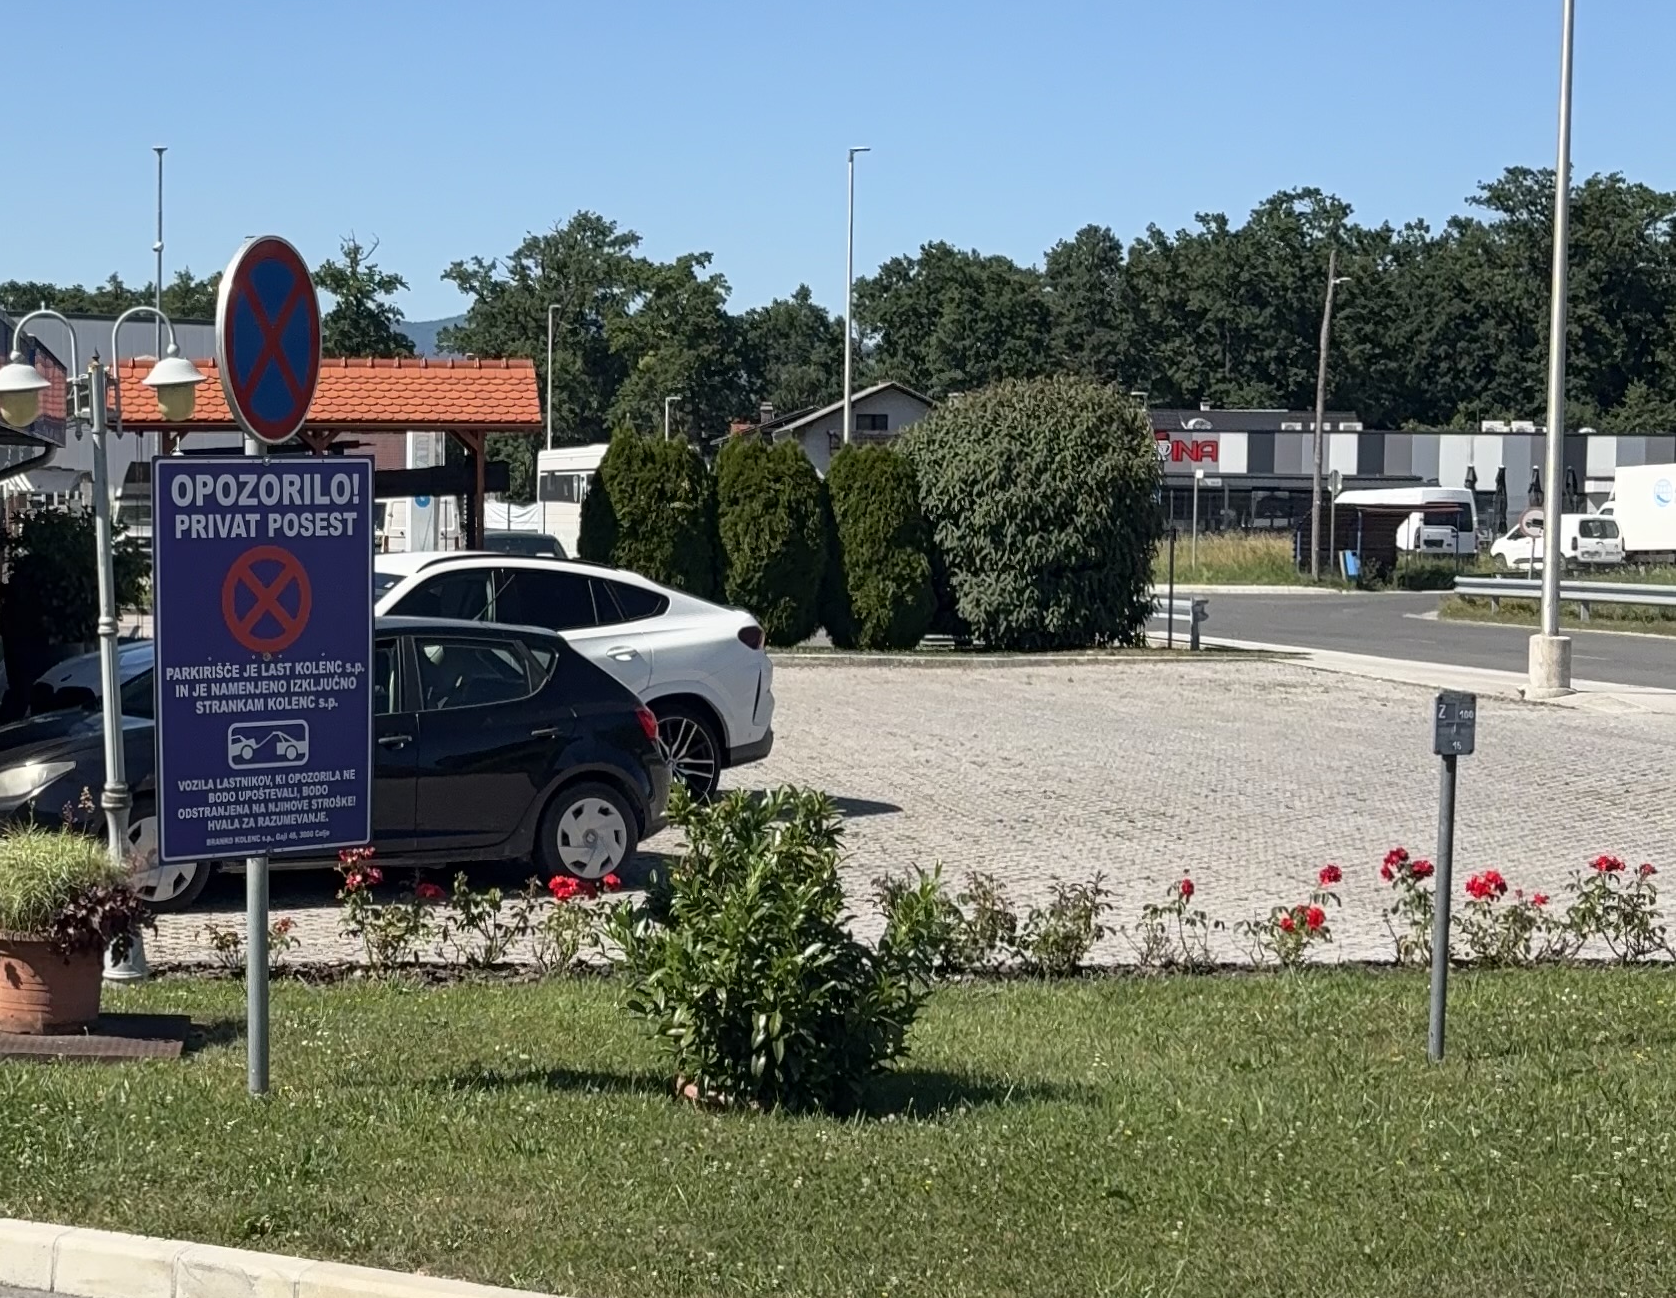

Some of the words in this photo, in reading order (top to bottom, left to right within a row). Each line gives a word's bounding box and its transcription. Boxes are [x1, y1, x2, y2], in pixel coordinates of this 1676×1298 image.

[171, 473, 360, 507] OPOZORILO!
[175, 513, 260, 539] PRIVAT
[268, 512, 358, 537] POSEST
[166, 662, 240, 681] PARKIRIŠČE
[243, 664, 258, 678] JE
[261, 662, 293, 677] LAST
[295, 660, 342, 675] KOLENC
[345, 661, 365, 675] s.p.
[175, 684, 189, 698] IN
[192, 683, 207, 697] JE
[210, 679, 287, 696] NAMENJENO
[290, 675, 357, 693] IZKLJUČNO
[195, 698, 264, 715] STRANKAM
[267, 695, 316, 711] KOLENC
[318, 696, 338, 710] s.p.
[1438, 704, 1447, 719] Z
[178, 779, 215, 792] VOZILA
[216, 775, 273, 790] LASTNIKOV,
[275, 774, 286, 785] KI
[288, 770, 341, 784] OPOZORILA
[343, 769, 356, 780] NE
[208, 791, 236, 804] BODO
[238, 787, 300, 802] UPOŠTEVALI,
[302, 784, 329, 797] BODO
[177, 804, 250, 820] ODSTRANJENA
[252, 802, 266, 814] NA
[268, 799, 309, 813] NJIHOVE
[311, 795, 356, 810] STROŠKE!
[207, 818, 240, 831] HVALA
[242, 817, 256, 829] ZA
[257, 812, 329, 828] RAZUMEVANJE.
[235, 834, 261, 844] KOLENC
